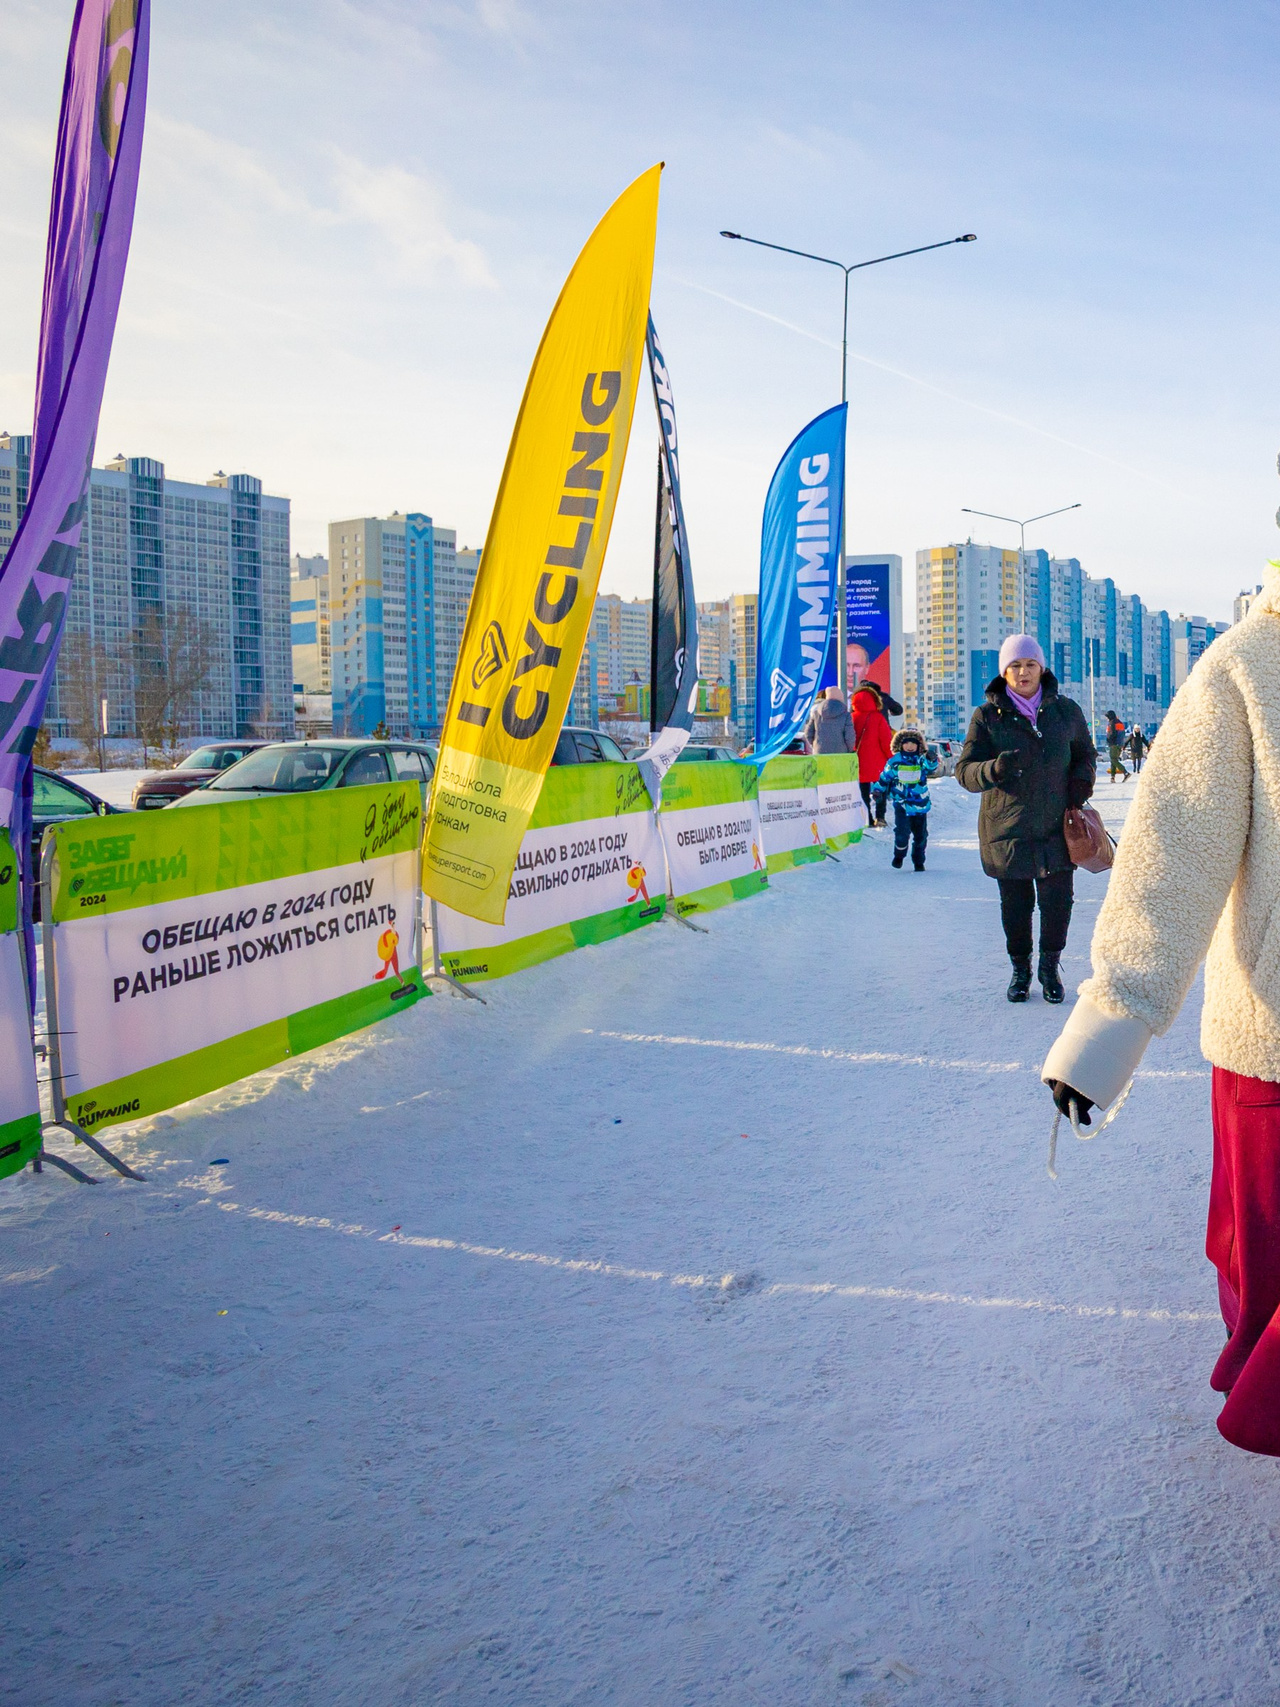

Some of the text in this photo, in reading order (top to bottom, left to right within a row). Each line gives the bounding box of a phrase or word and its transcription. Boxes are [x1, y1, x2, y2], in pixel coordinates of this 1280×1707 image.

[502, 371, 621, 740] CYCLING
[513, 832, 628, 871] ЩАЮ В 2024 ГОДУ
[677, 825, 716, 847] ОБЕЩАЮ
[508, 855, 633, 900] АВИЛЬНО ОТДЫХАТЬ
[80, 894, 106, 907] 2024
[142, 878, 375, 954] ОБЕЩАЮ В 2024 ГОДУ
[113, 904, 397, 1004] РАНЬШЕ ЛОЖИТЬСЯ СПАТЬ
[451, 964, 488, 978] RUNNING
[77, 1099, 140, 1128] RUNNING
